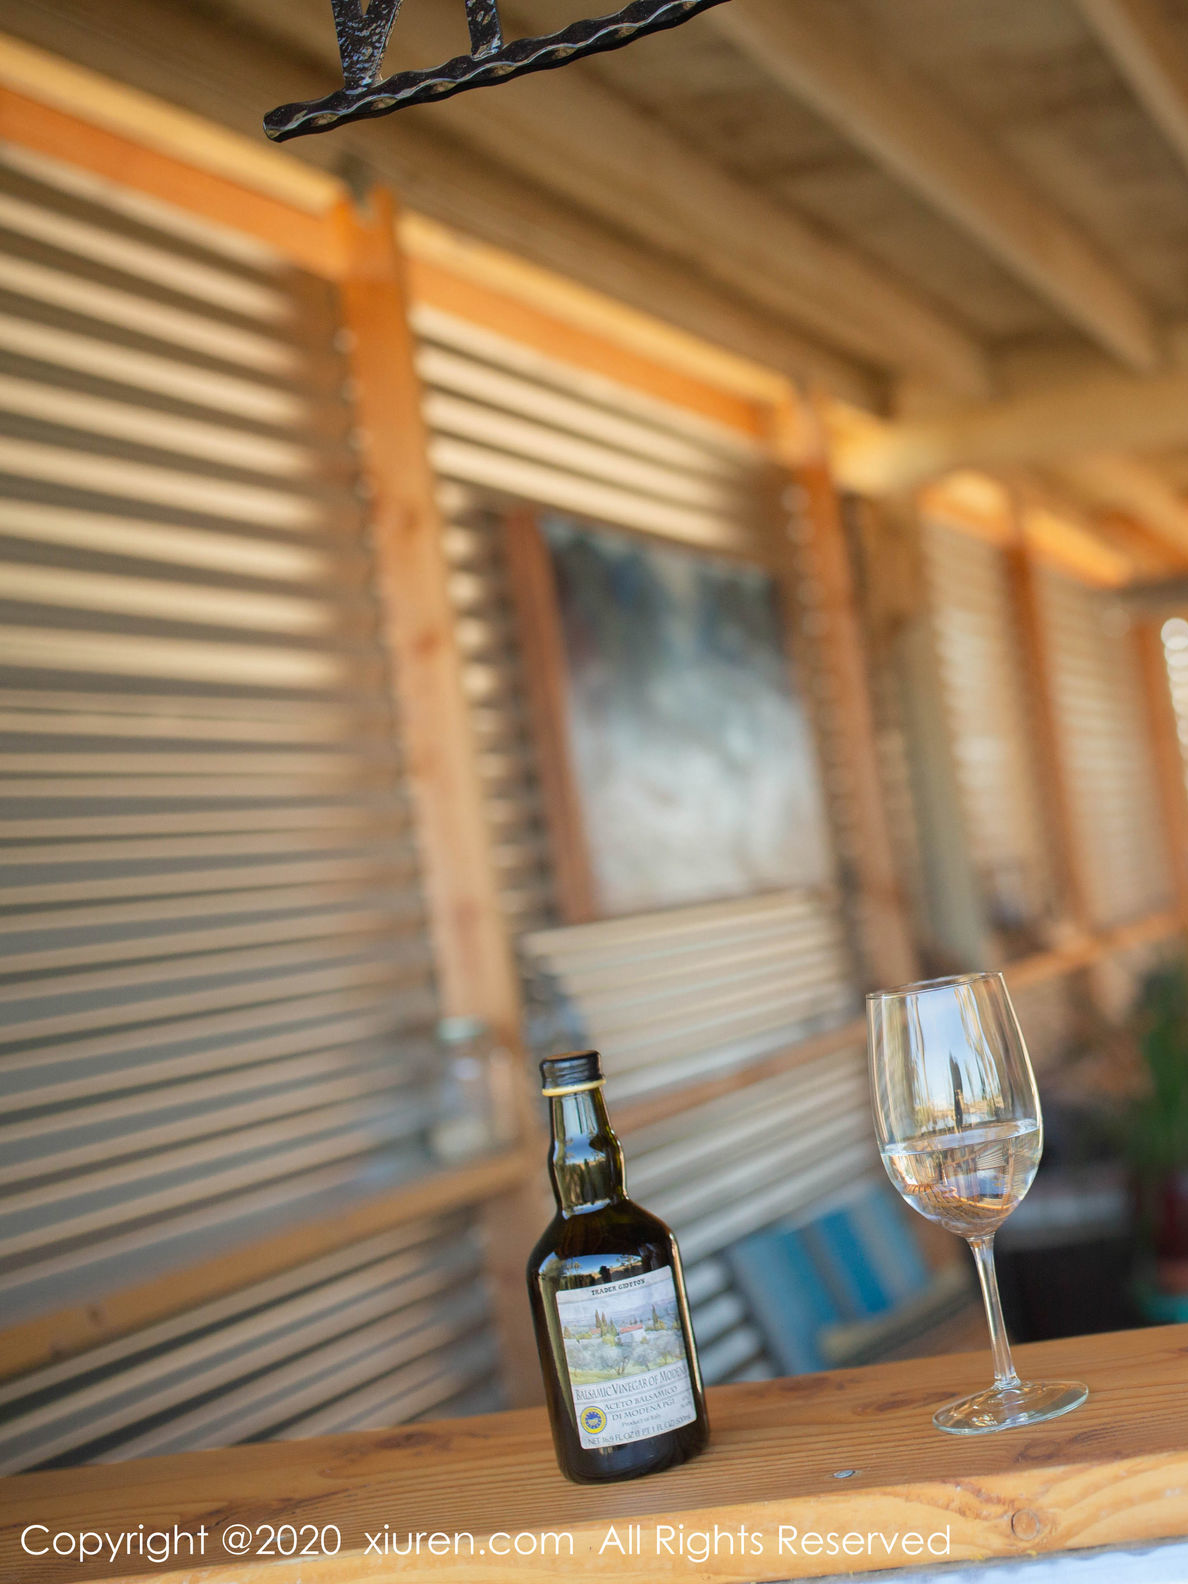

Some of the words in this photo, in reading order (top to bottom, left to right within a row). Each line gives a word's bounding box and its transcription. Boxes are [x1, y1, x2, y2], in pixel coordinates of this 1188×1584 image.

[591, 1285, 616, 1295] TRADER
[575, 1385, 611, 1401] BALSAMIC
[611, 1378, 648, 1395] VINEGAR
[604, 1399, 633, 1411] ACETO
[634, 1385, 678, 1405] BALSAMICO
[612, 1413, 622, 1421] DI
[623, 1403, 661, 1418] MODENA
